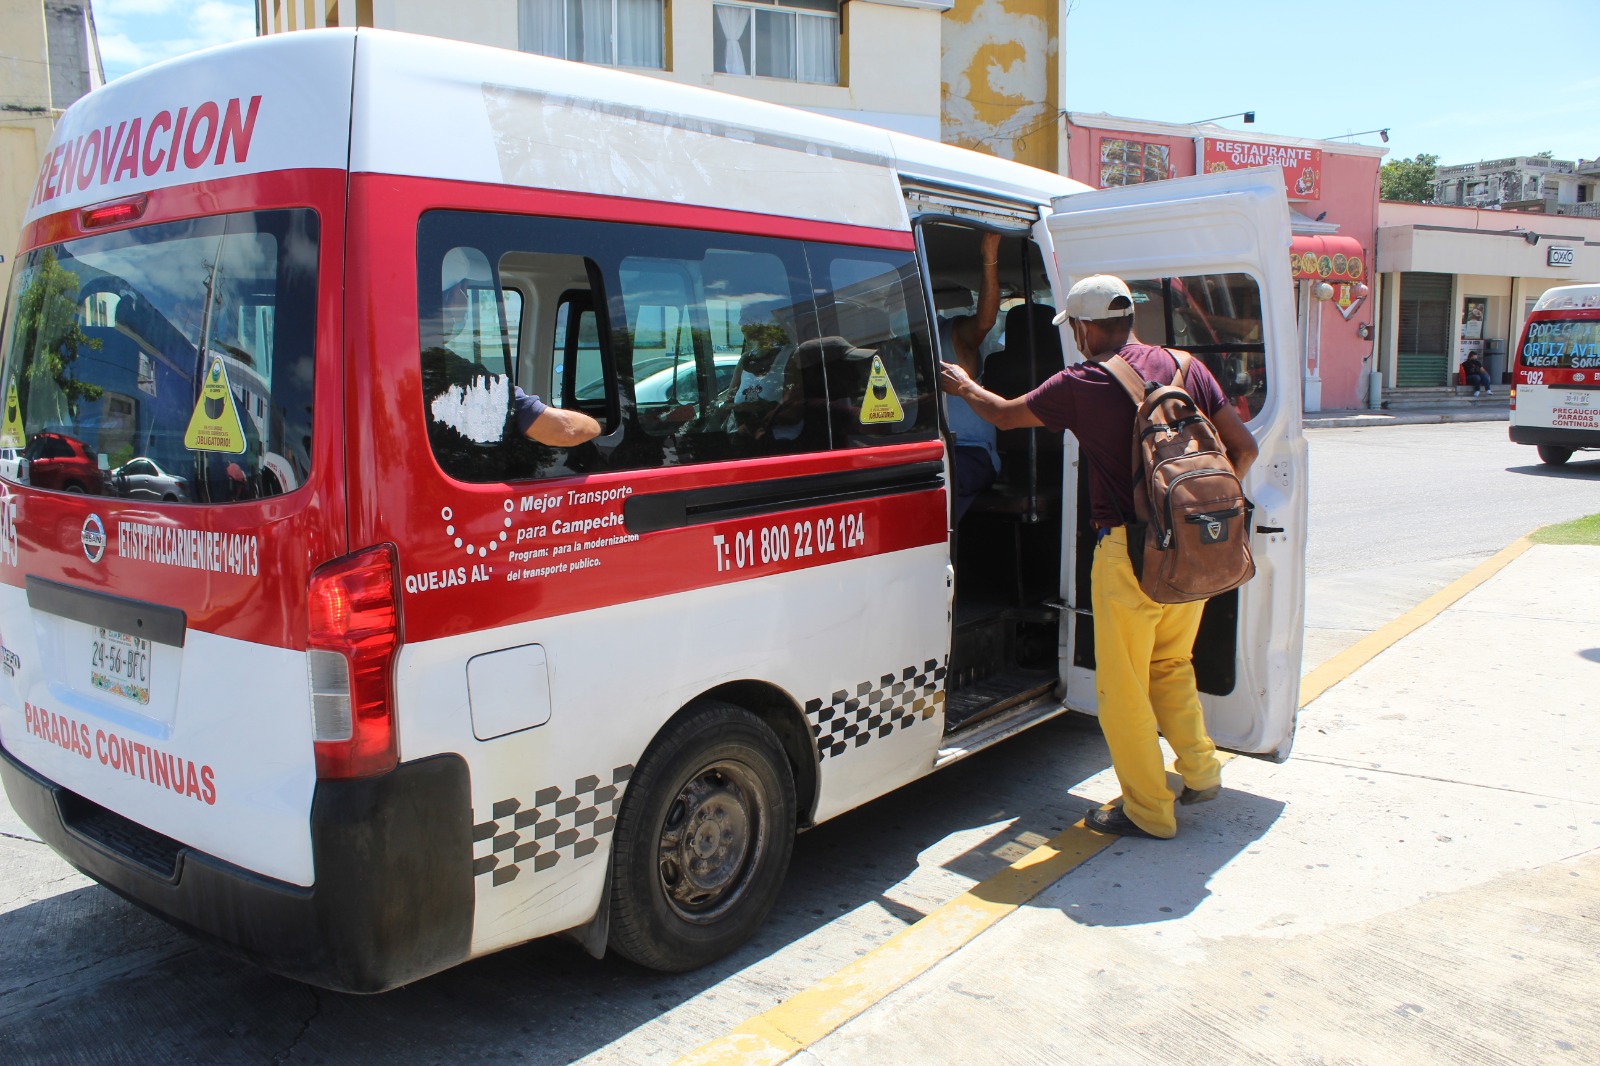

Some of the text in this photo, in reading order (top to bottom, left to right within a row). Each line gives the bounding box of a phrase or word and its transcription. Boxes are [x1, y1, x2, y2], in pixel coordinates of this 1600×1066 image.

[31, 95, 263, 209] RENOVACION
[1216, 141, 1312, 160] RESTAURANTE
[1231, 153, 1297, 168] QUAN SHUN
[1552, 251, 1574, 262] OXXO
[1523, 341, 1564, 357] ORTIZ
[1527, 356, 1558, 367] MEGA
[1527, 371, 1544, 385] 092
[1552, 420, 1599, 428] CONTINUAS
[1557, 414, 1594, 422] PARADAS
[520, 485, 633, 513] Mejor Transporte
[516, 512, 625, 544] para Campeche
[552, 544, 572, 557] para
[573, 541, 582, 552] la
[713, 512, 865, 572] T: 01 800 22 02 124
[507, 557, 601, 582] del transporte publico.
[405, 566, 467, 594] QUEJAS
[92, 640, 146, 682] 24-56-BFC
[24, 701, 217, 806] PARADAS CONTINUAS
